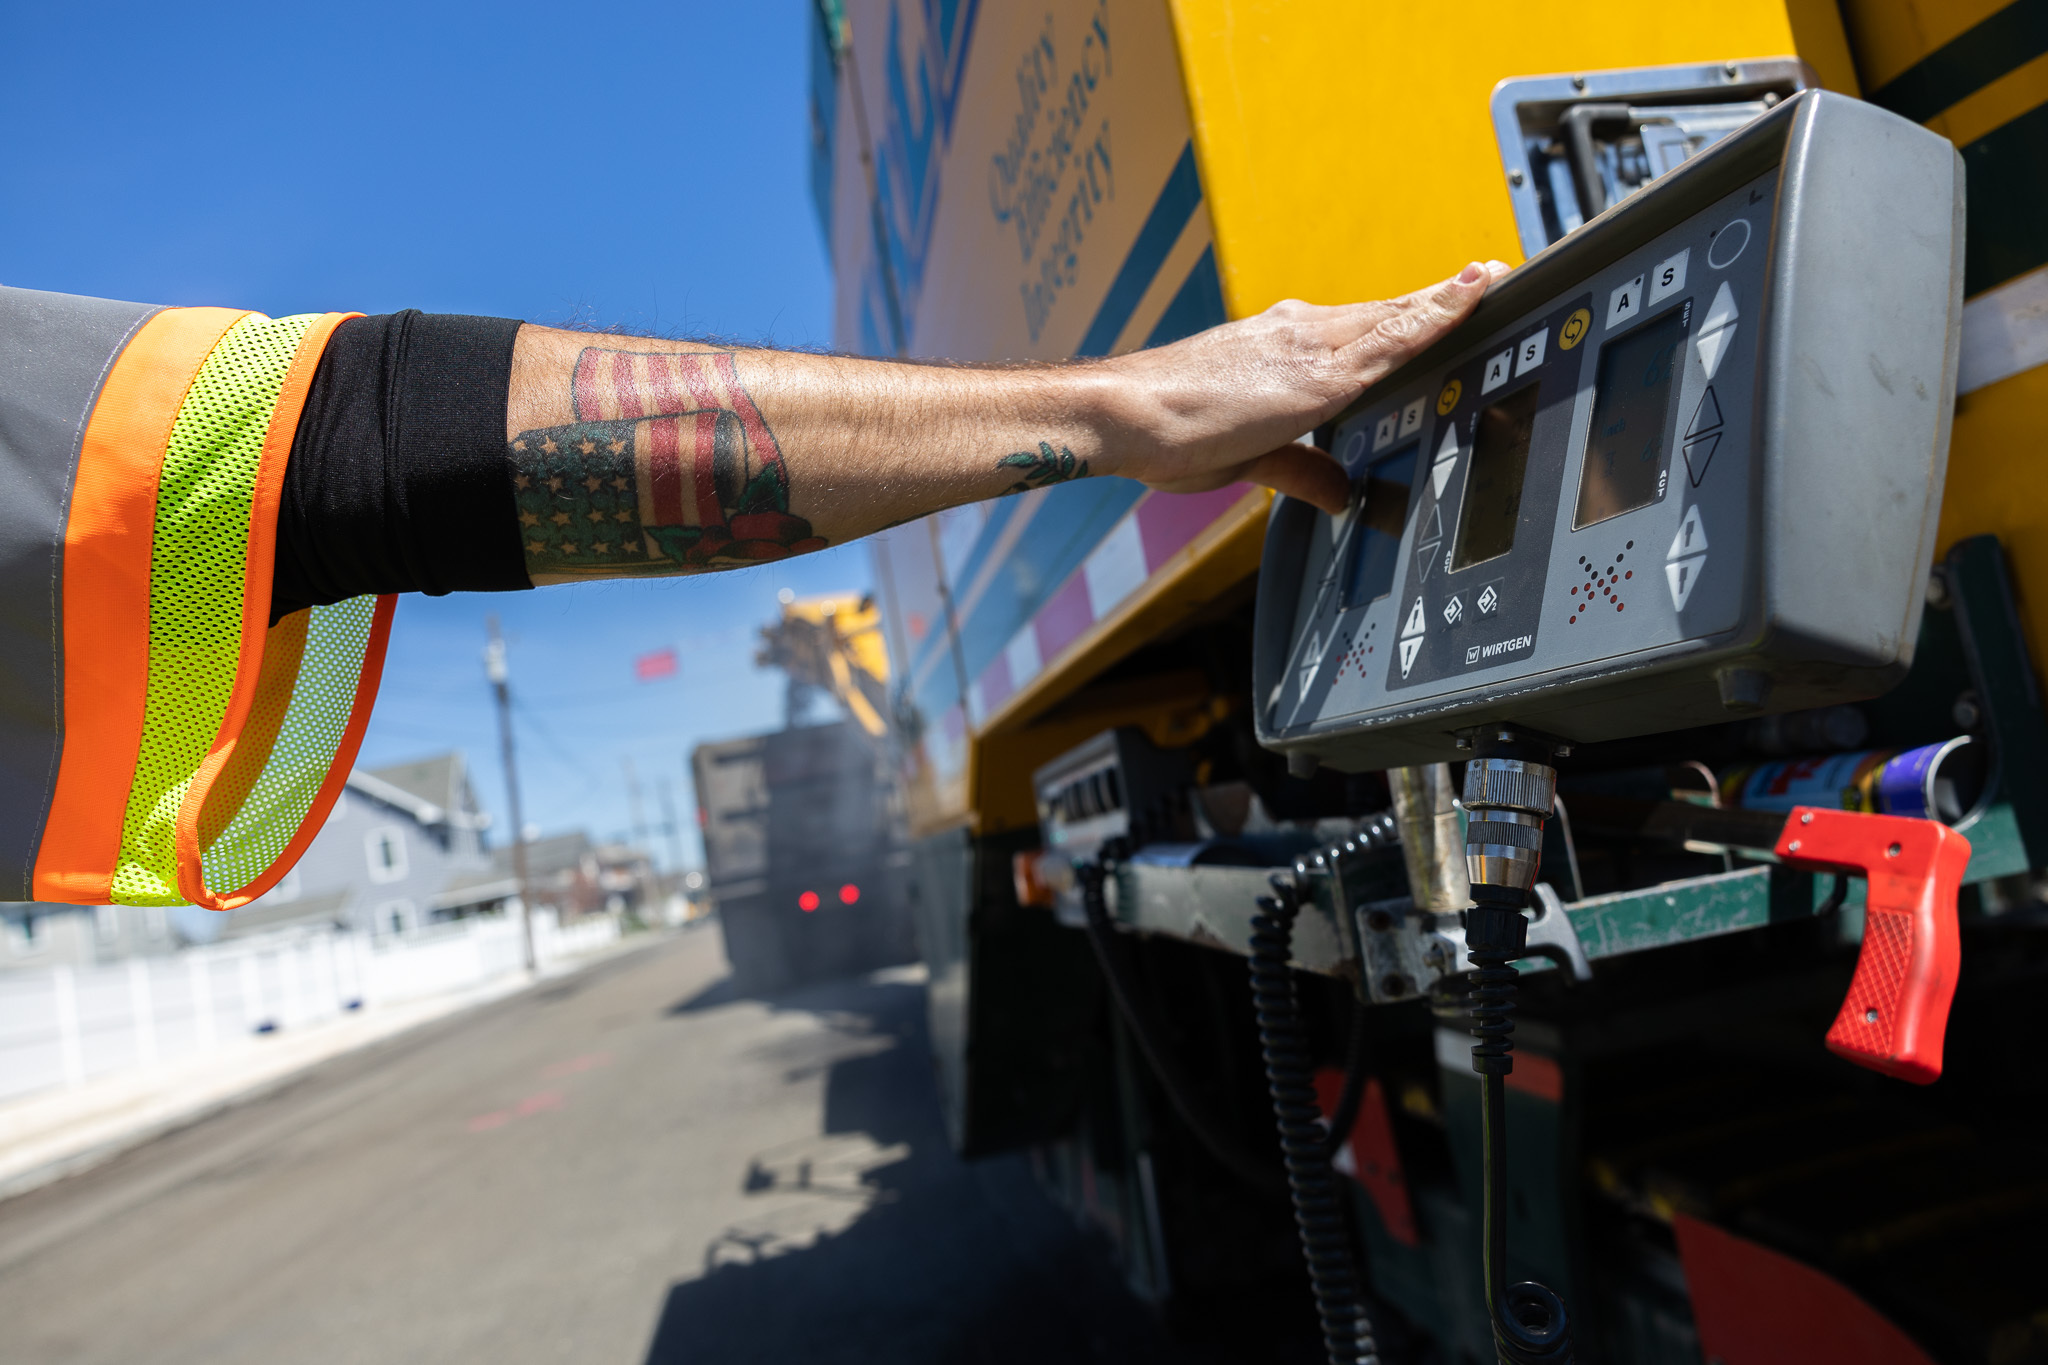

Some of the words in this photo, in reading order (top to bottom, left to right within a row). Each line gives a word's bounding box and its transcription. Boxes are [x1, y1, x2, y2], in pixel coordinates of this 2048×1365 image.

[988, 12, 1059, 226] Quality
[1021, 119, 1115, 345] Integrity
[1660, 268, 1675, 288] S
[1616, 293, 1630, 314] A
[1682, 301, 1691, 328] SET
[1526, 344, 1537, 362] S
[1489, 363, 1501, 382] A
[1406, 409, 1417, 425] S
[1379, 424, 1389, 440] A
[1657, 469, 1668, 498] ACT
[1443, 550, 1452, 574] ACT
[1482, 634, 1532, 658] WIRTGEN
